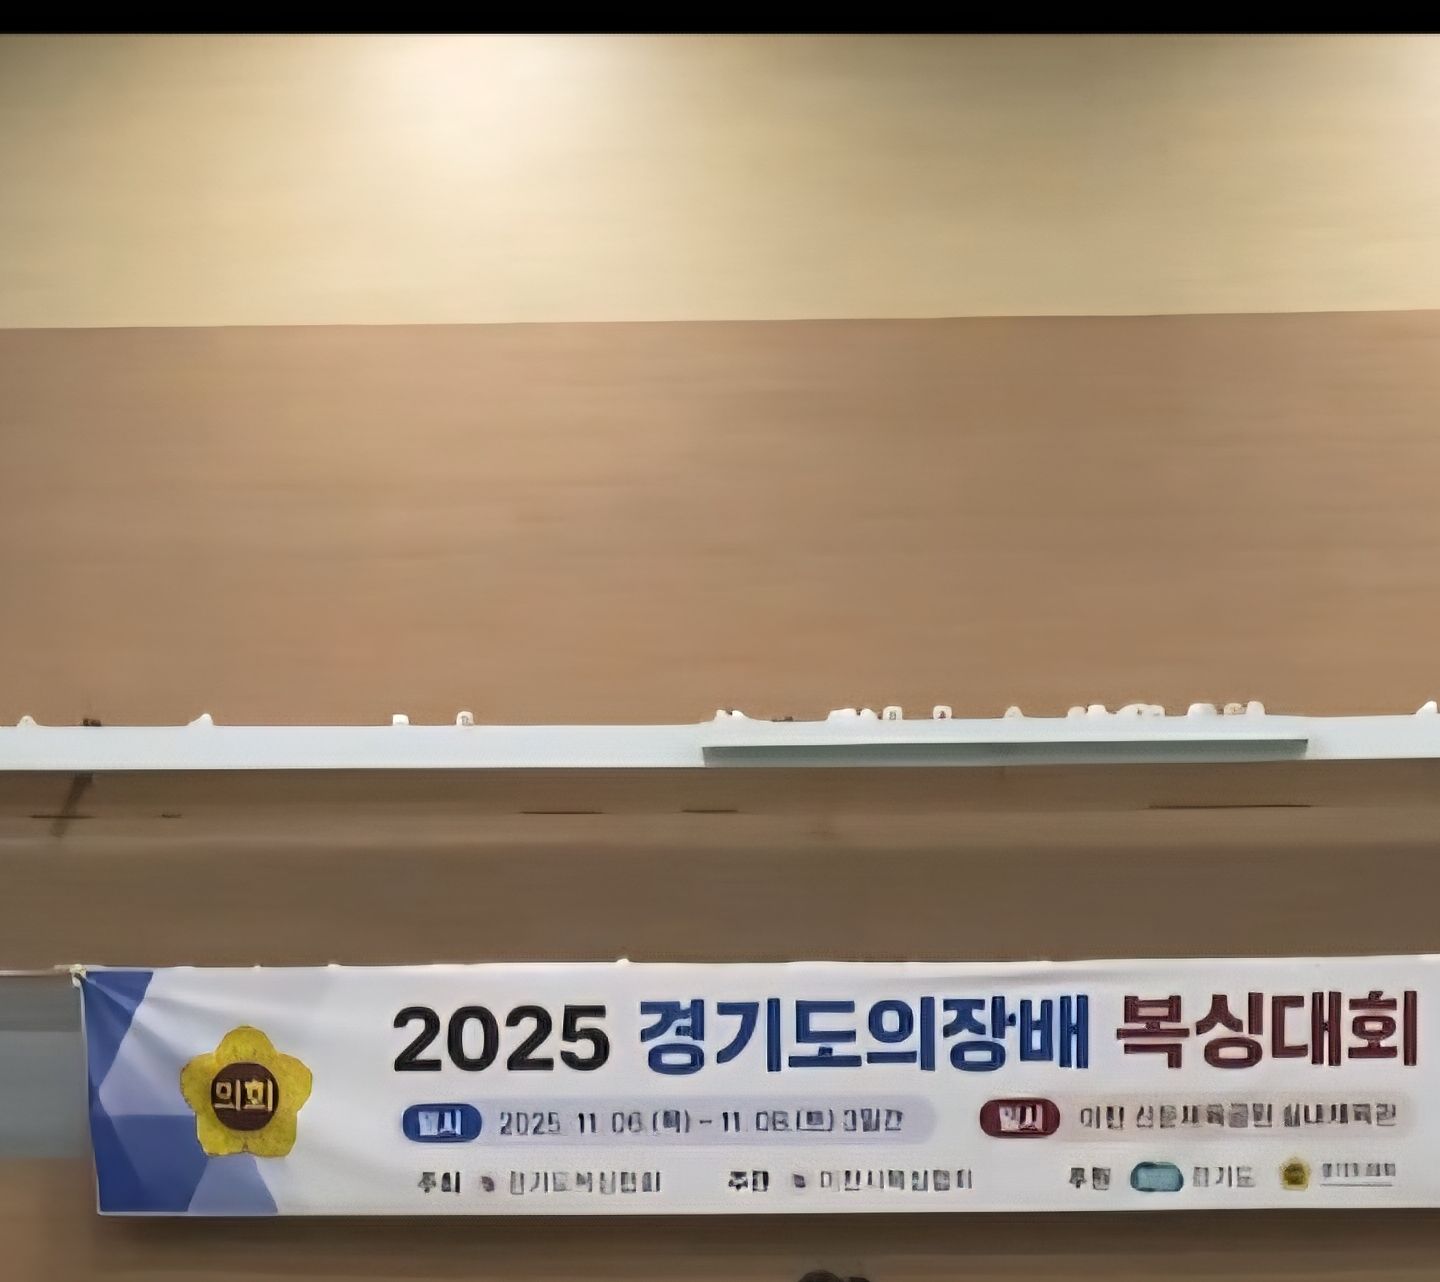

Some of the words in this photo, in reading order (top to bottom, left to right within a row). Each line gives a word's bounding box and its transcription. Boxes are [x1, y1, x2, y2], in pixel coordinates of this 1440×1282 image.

[392, 1003, 611, 1073] 2025
[640, 994, 1090, 1076] 경기도의장배
[1116, 989, 1418, 1070] 복싱대회
[213, 1078, 274, 1112] 의회
